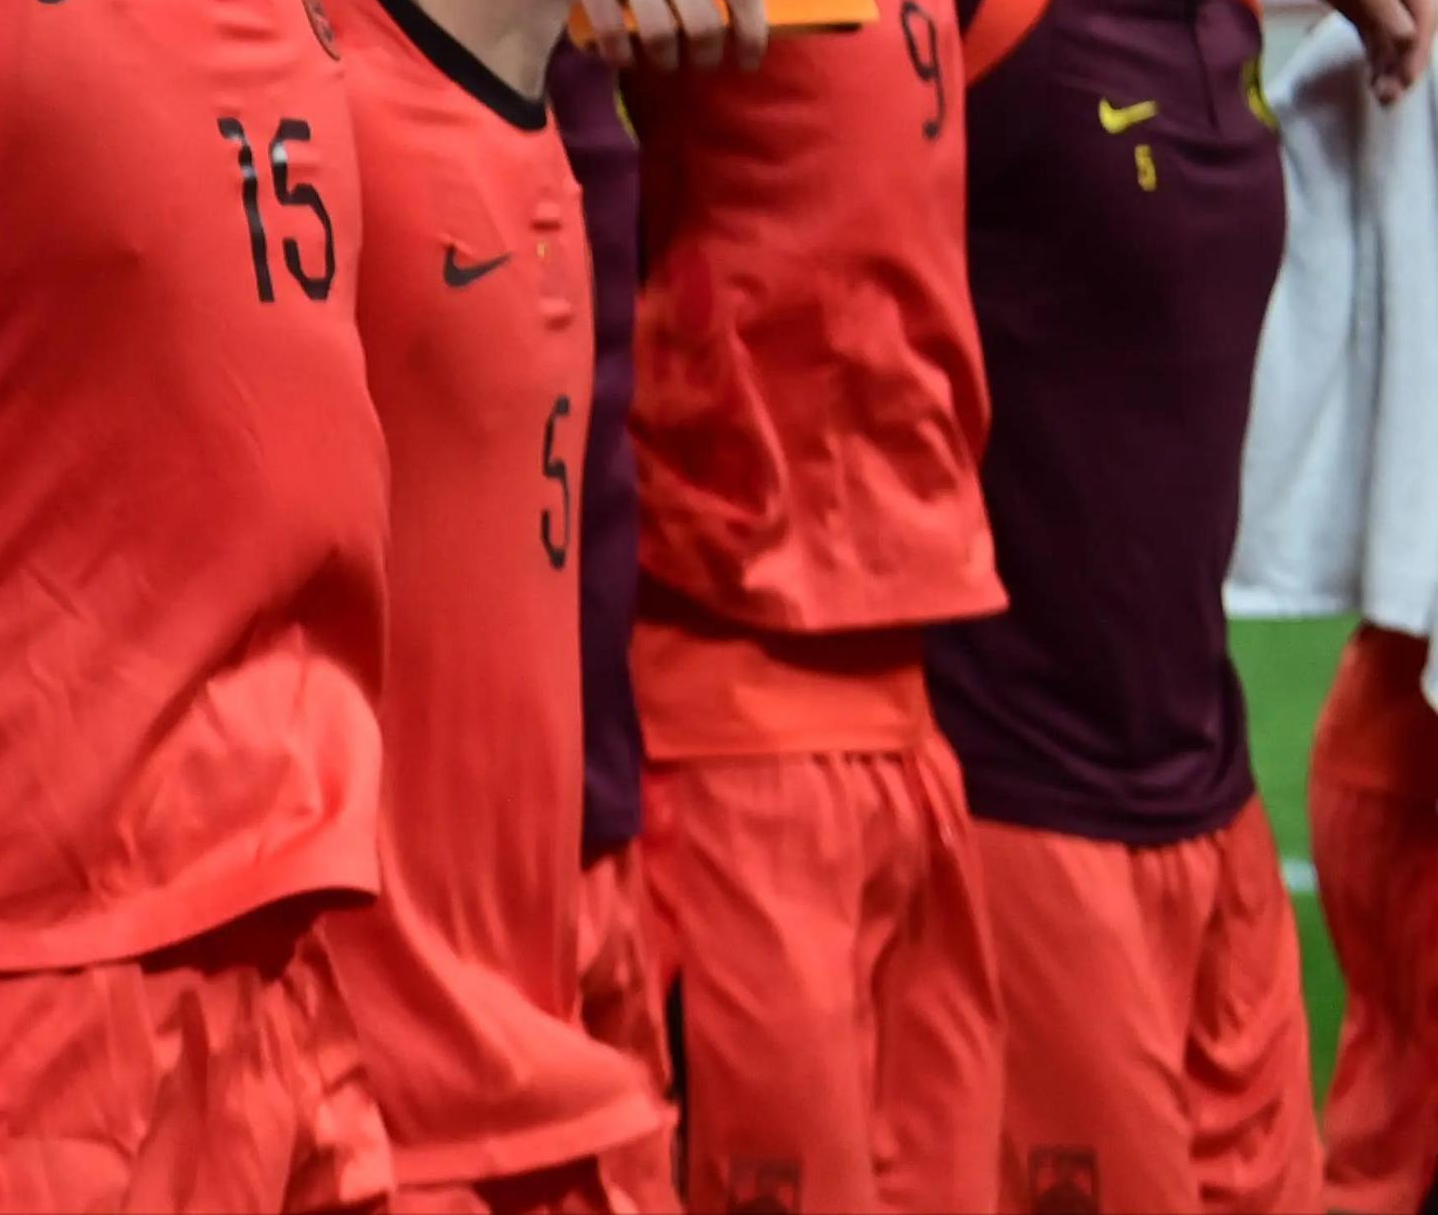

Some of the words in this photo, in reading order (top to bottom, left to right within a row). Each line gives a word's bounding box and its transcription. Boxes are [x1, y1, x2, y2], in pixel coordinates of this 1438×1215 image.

[900, 0, 945, 140] 9
[217, 118, 336, 303] 15
[540, 395, 571, 571] 5
